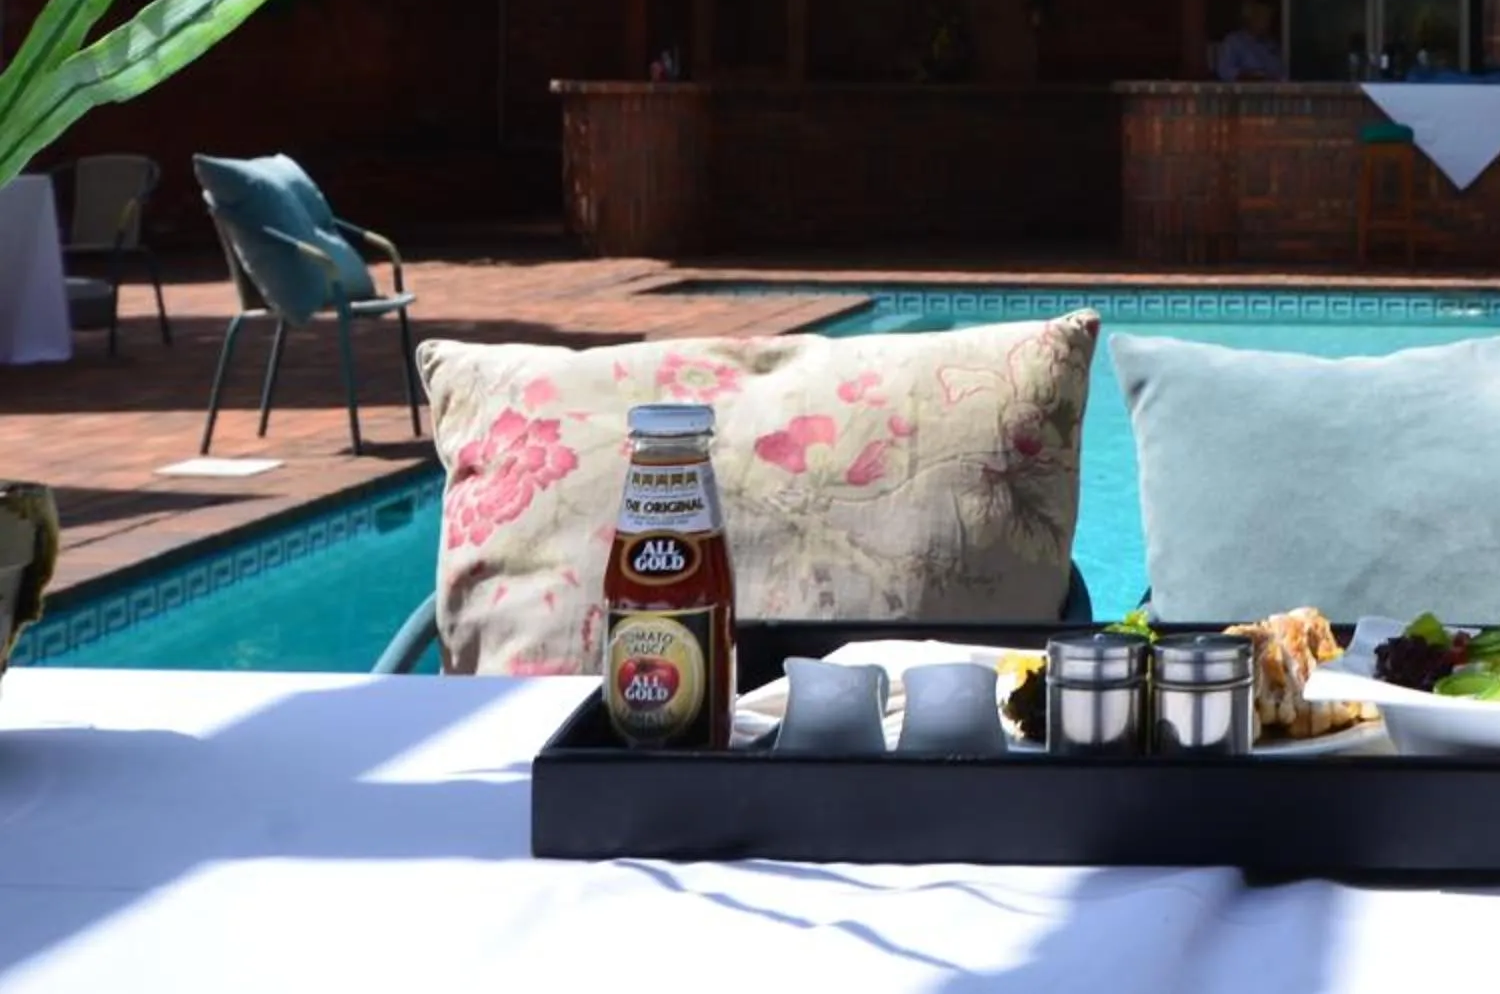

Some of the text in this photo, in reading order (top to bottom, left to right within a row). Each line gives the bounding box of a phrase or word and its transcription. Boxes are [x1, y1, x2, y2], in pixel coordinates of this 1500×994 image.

[643, 540, 679, 555] ALL
[634, 555, 685, 572] GOLD
[631, 675, 661, 687] ALL
[625, 687, 669, 700] GOLD
